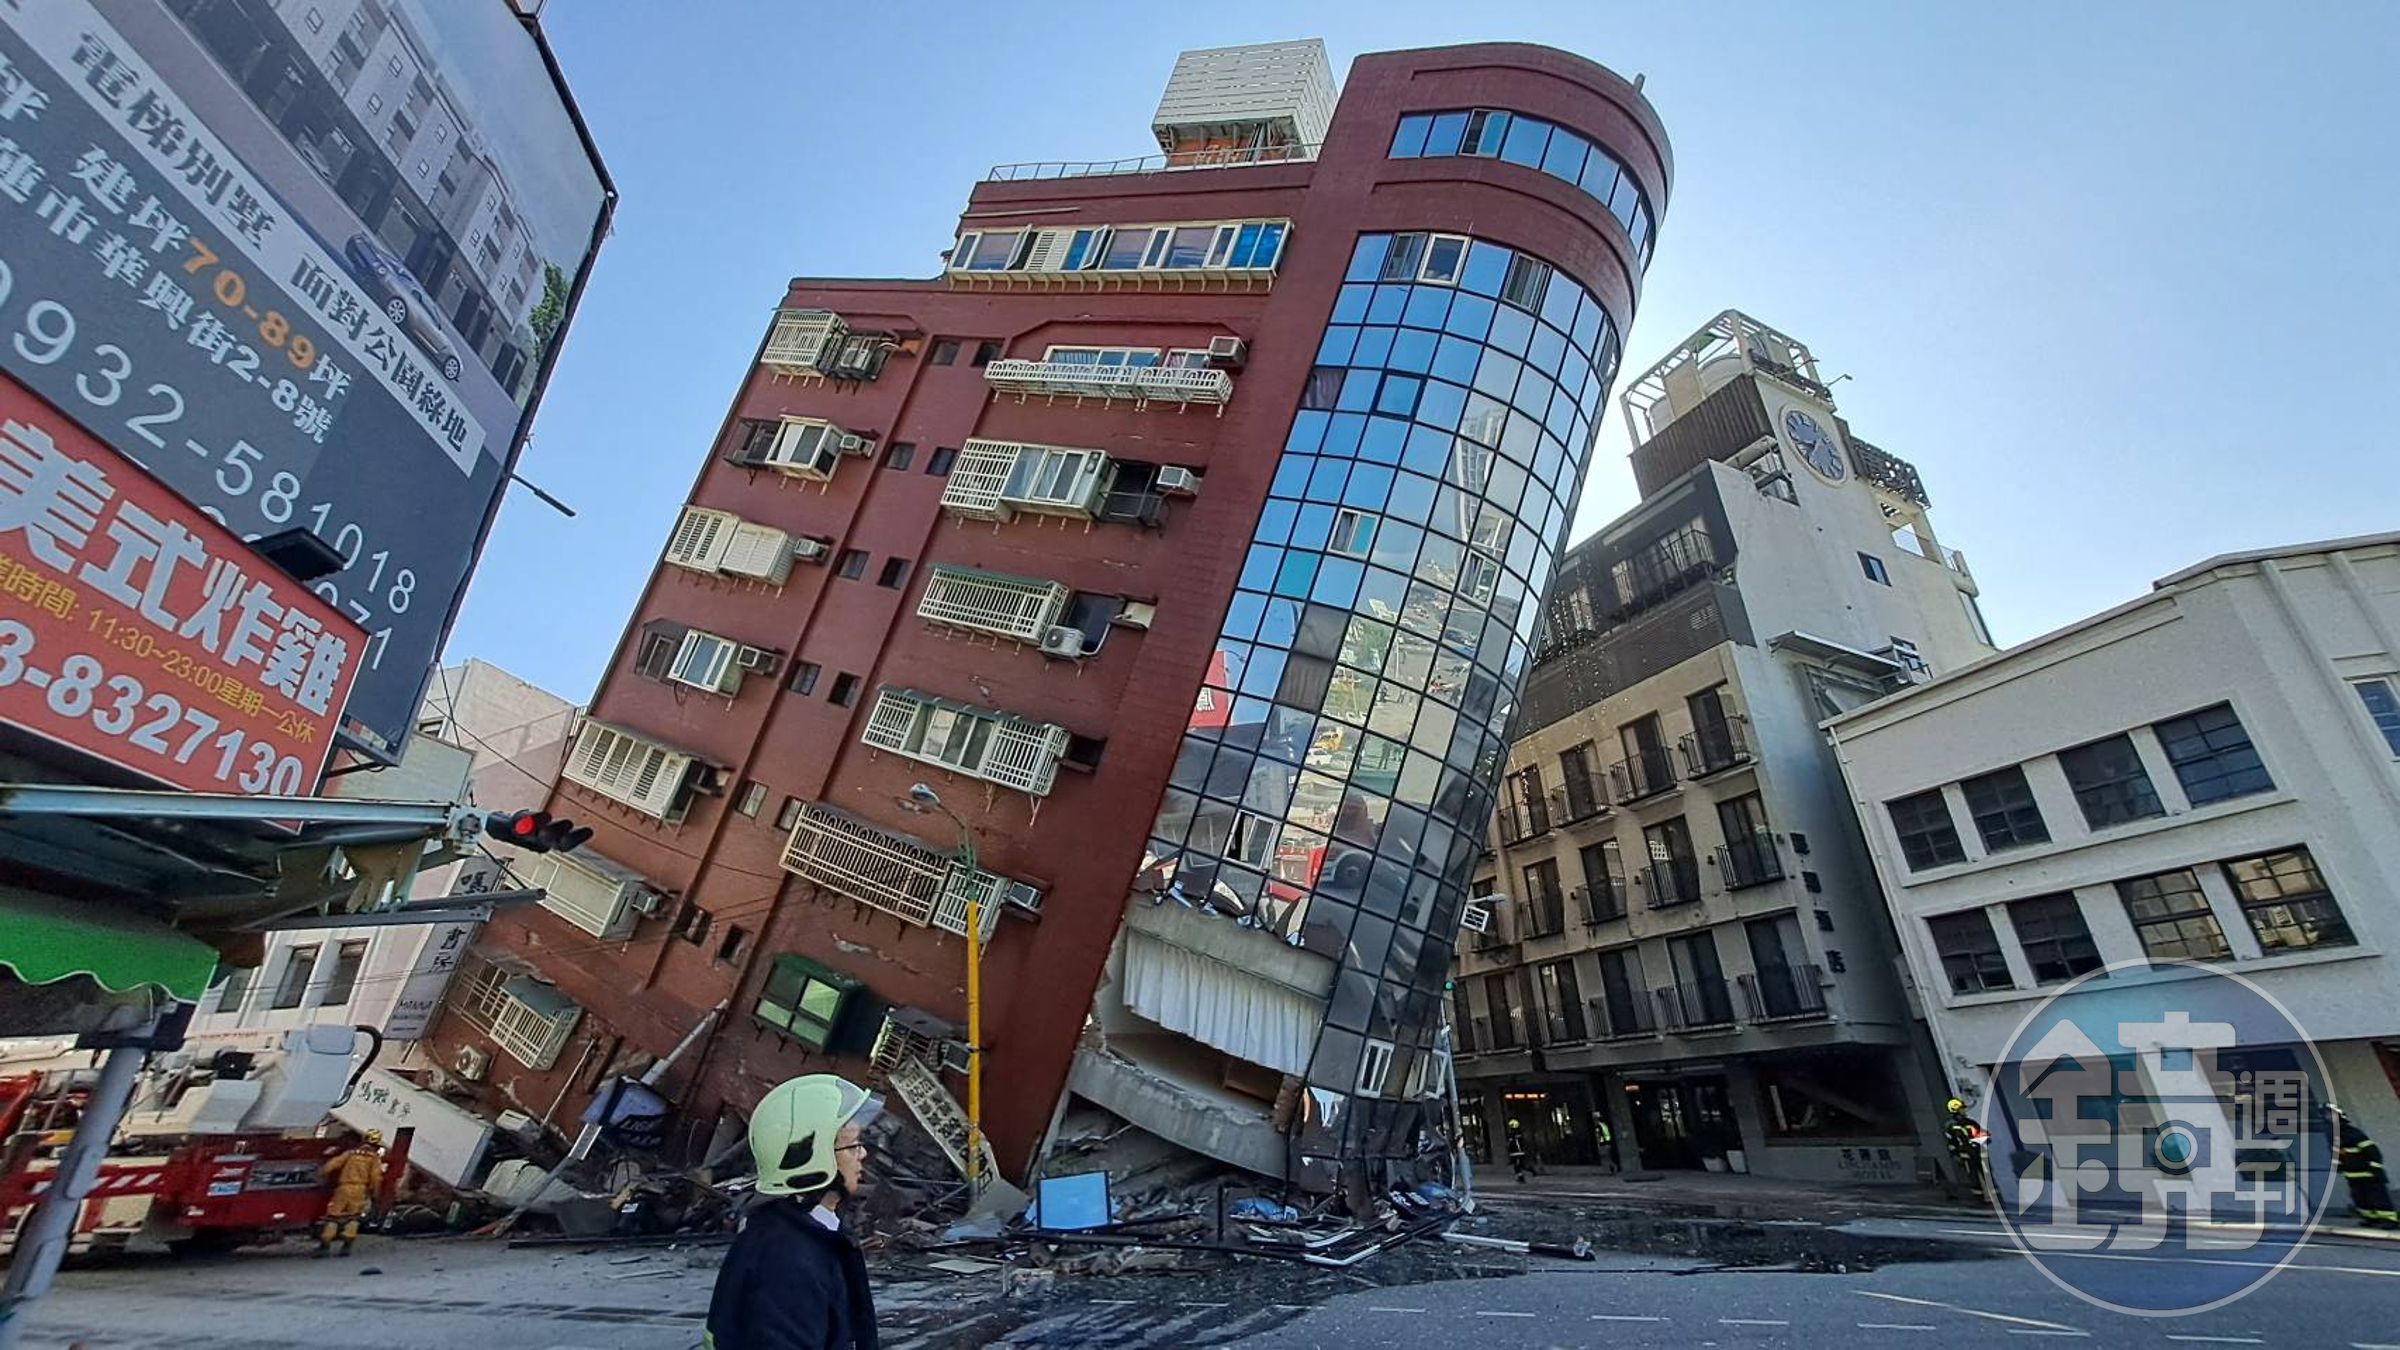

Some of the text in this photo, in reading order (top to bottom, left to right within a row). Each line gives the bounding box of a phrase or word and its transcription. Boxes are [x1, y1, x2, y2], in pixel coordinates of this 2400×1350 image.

[71, 31, 277, 253] 電梯別墅
[290, 254, 467, 452] 面對公園綠地
[0, 418, 348, 716] 美式炸雞
